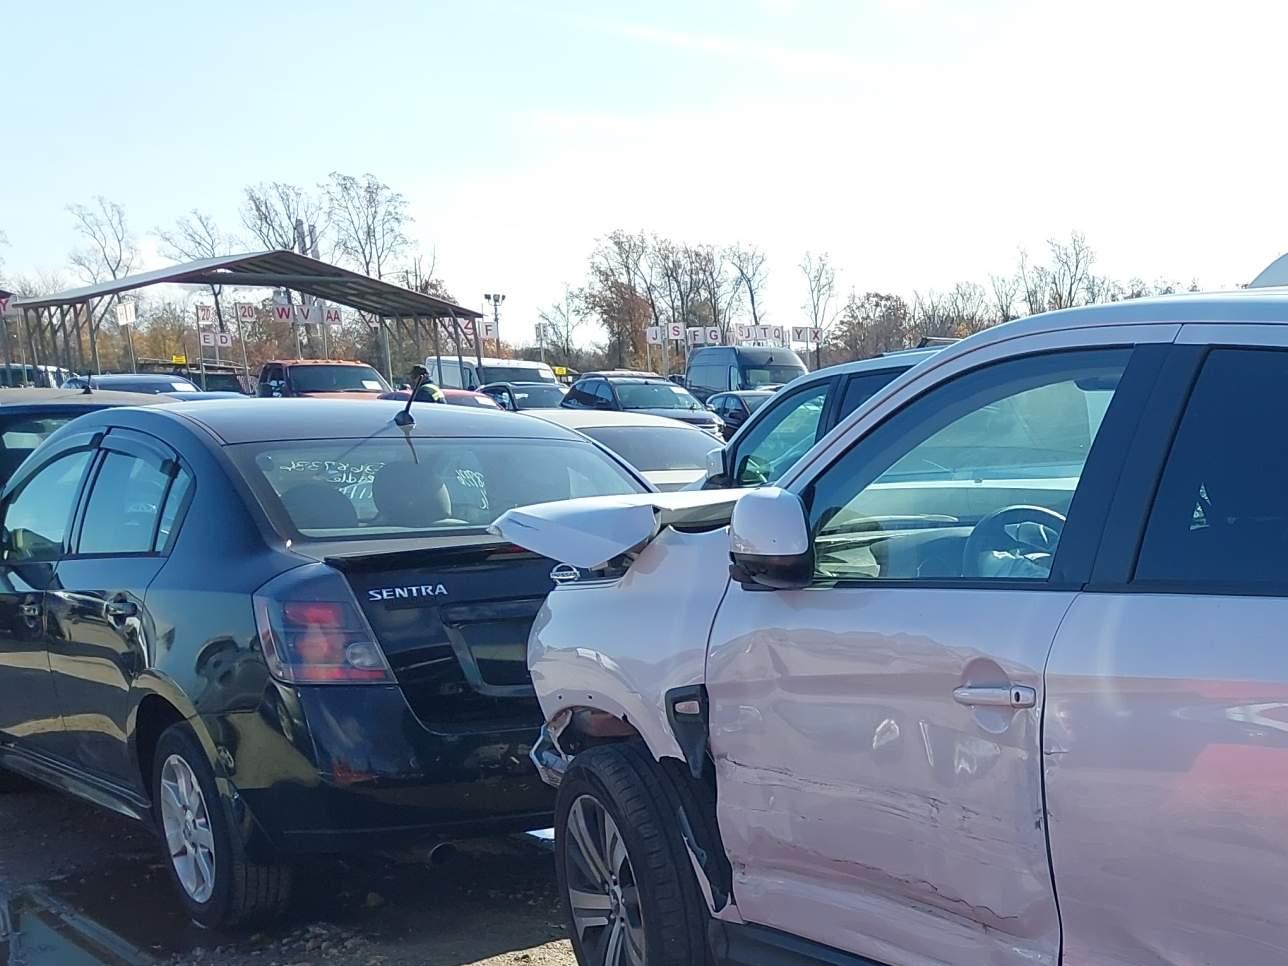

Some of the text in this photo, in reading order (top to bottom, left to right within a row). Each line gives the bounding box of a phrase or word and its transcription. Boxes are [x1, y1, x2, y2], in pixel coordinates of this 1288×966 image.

[201, 308, 211, 321] 20
[240, 305, 254, 318] 20
[276, 306, 291, 320] W
[300, 308, 310, 320] V
[325, 310, 341, 321] AA
[485, 325, 493, 336] F
[652, 331, 658, 341] J
[672, 326, 681, 337] S
[709, 330, 719, 340] G
[745, 328, 751, 339] J
[773, 328, 781, 339] Q
[795, 329, 803, 340] Y
[813, 329, 821, 341] X
[203, 334, 211, 344] E
[220, 335, 228, 345] D
[368, 583, 449, 601] SENTRA
